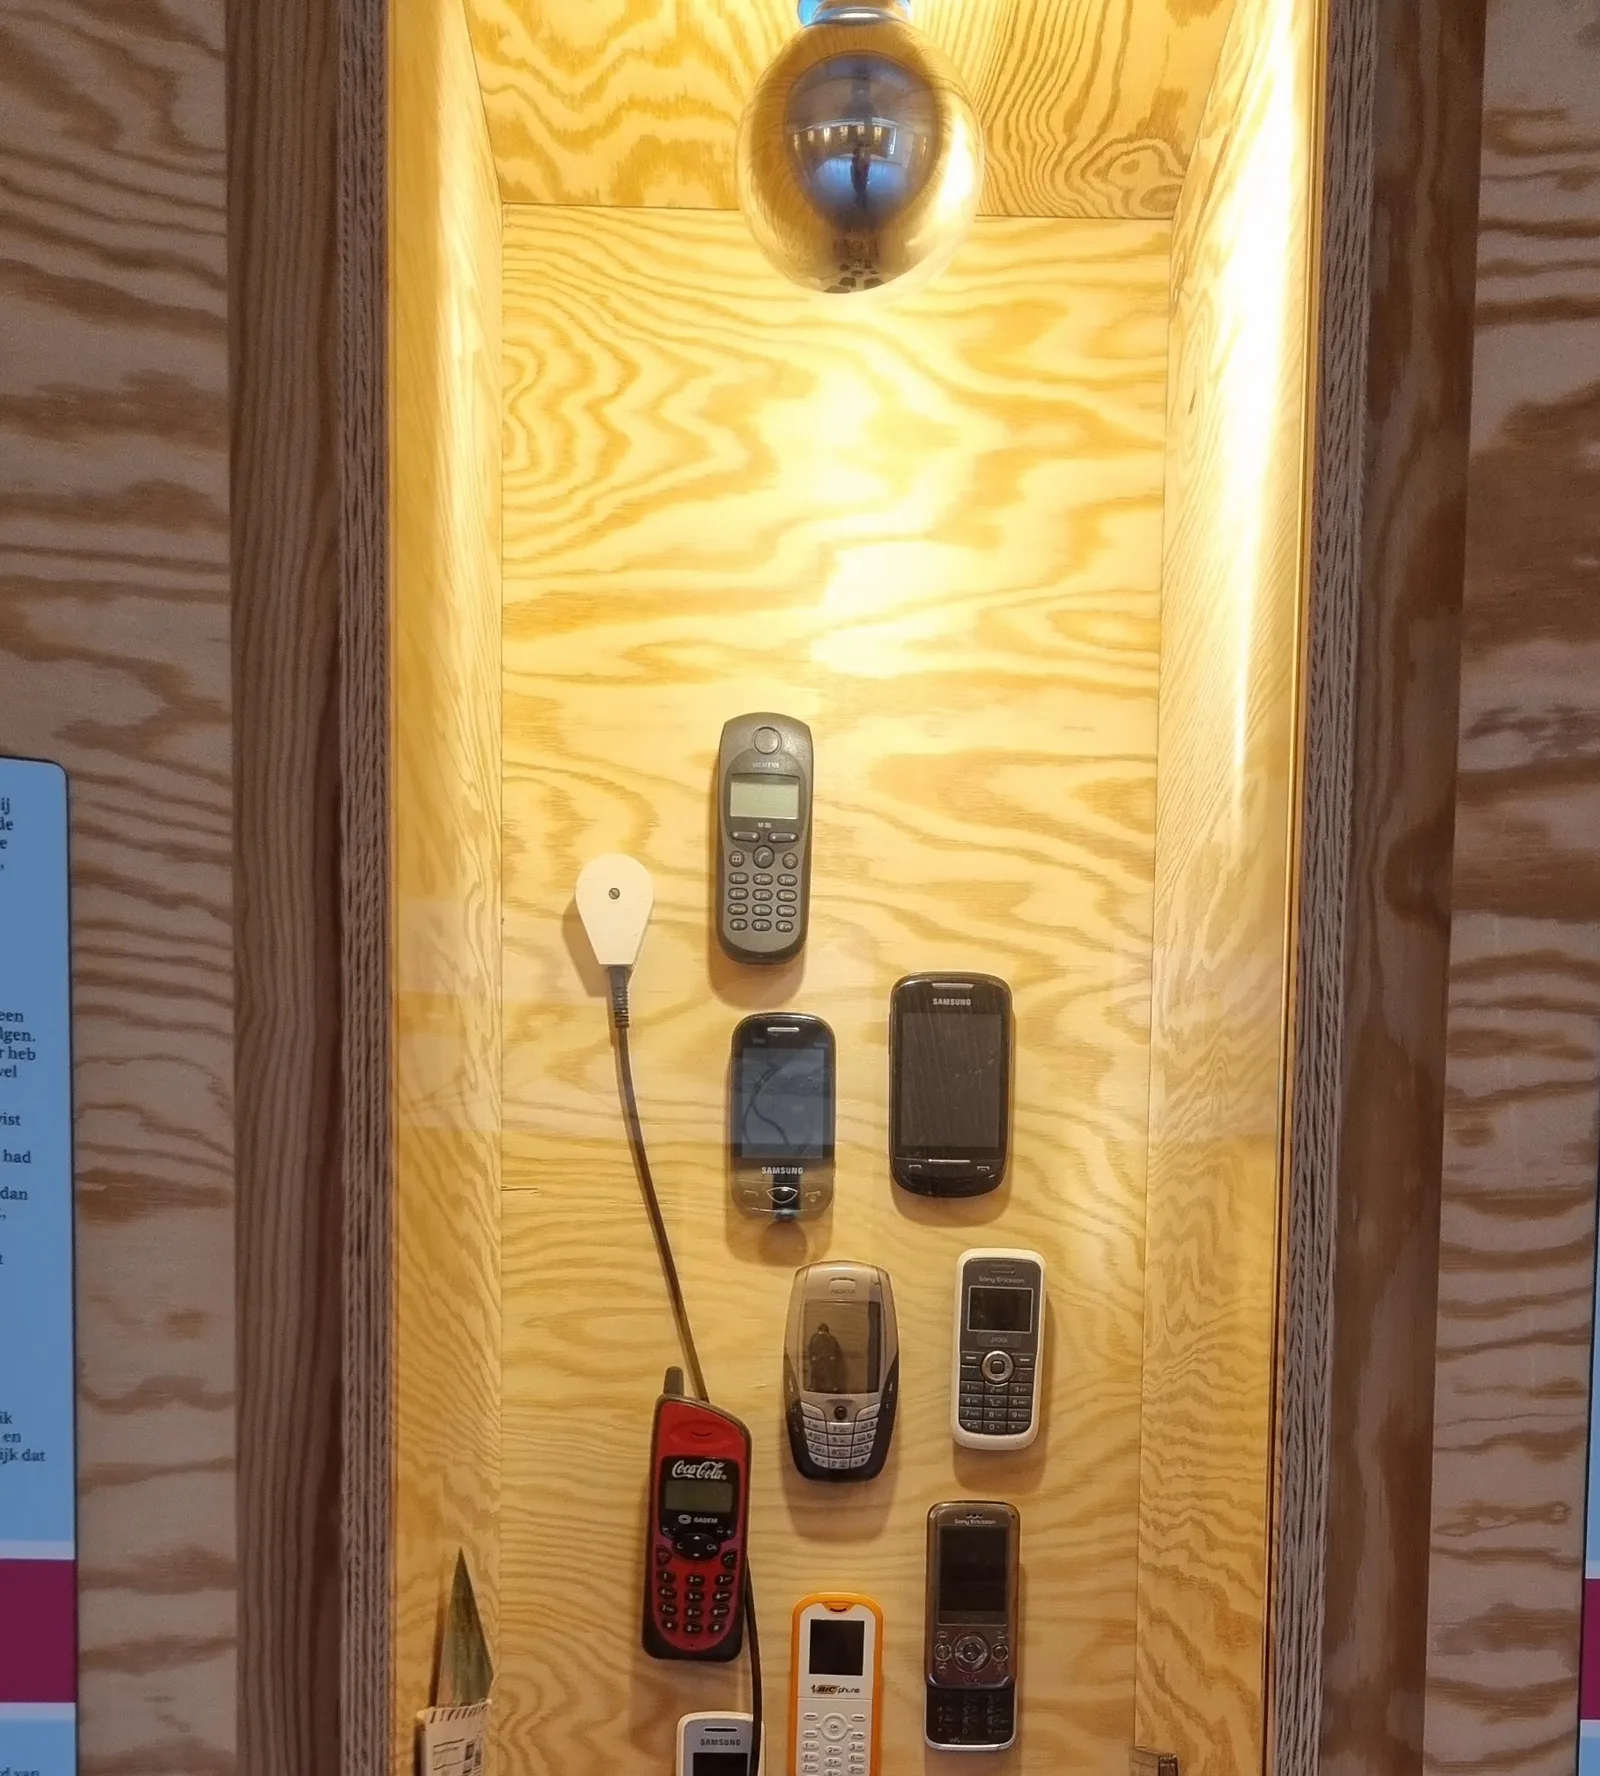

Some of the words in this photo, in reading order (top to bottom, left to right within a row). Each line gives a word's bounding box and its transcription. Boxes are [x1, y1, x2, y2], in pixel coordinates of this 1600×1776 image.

[932, 998, 972, 1006] SAMSUNG
[8, 1046, 36, 1061] heb
[3, 1149, 31, 1164] had
[761, 1166, 804, 1175] SAMSUNG
[0, 1186, 28, 1200] dan
[21, 1448, 46, 1462] dat
[700, 1738, 741, 1747] SAMSUNG
